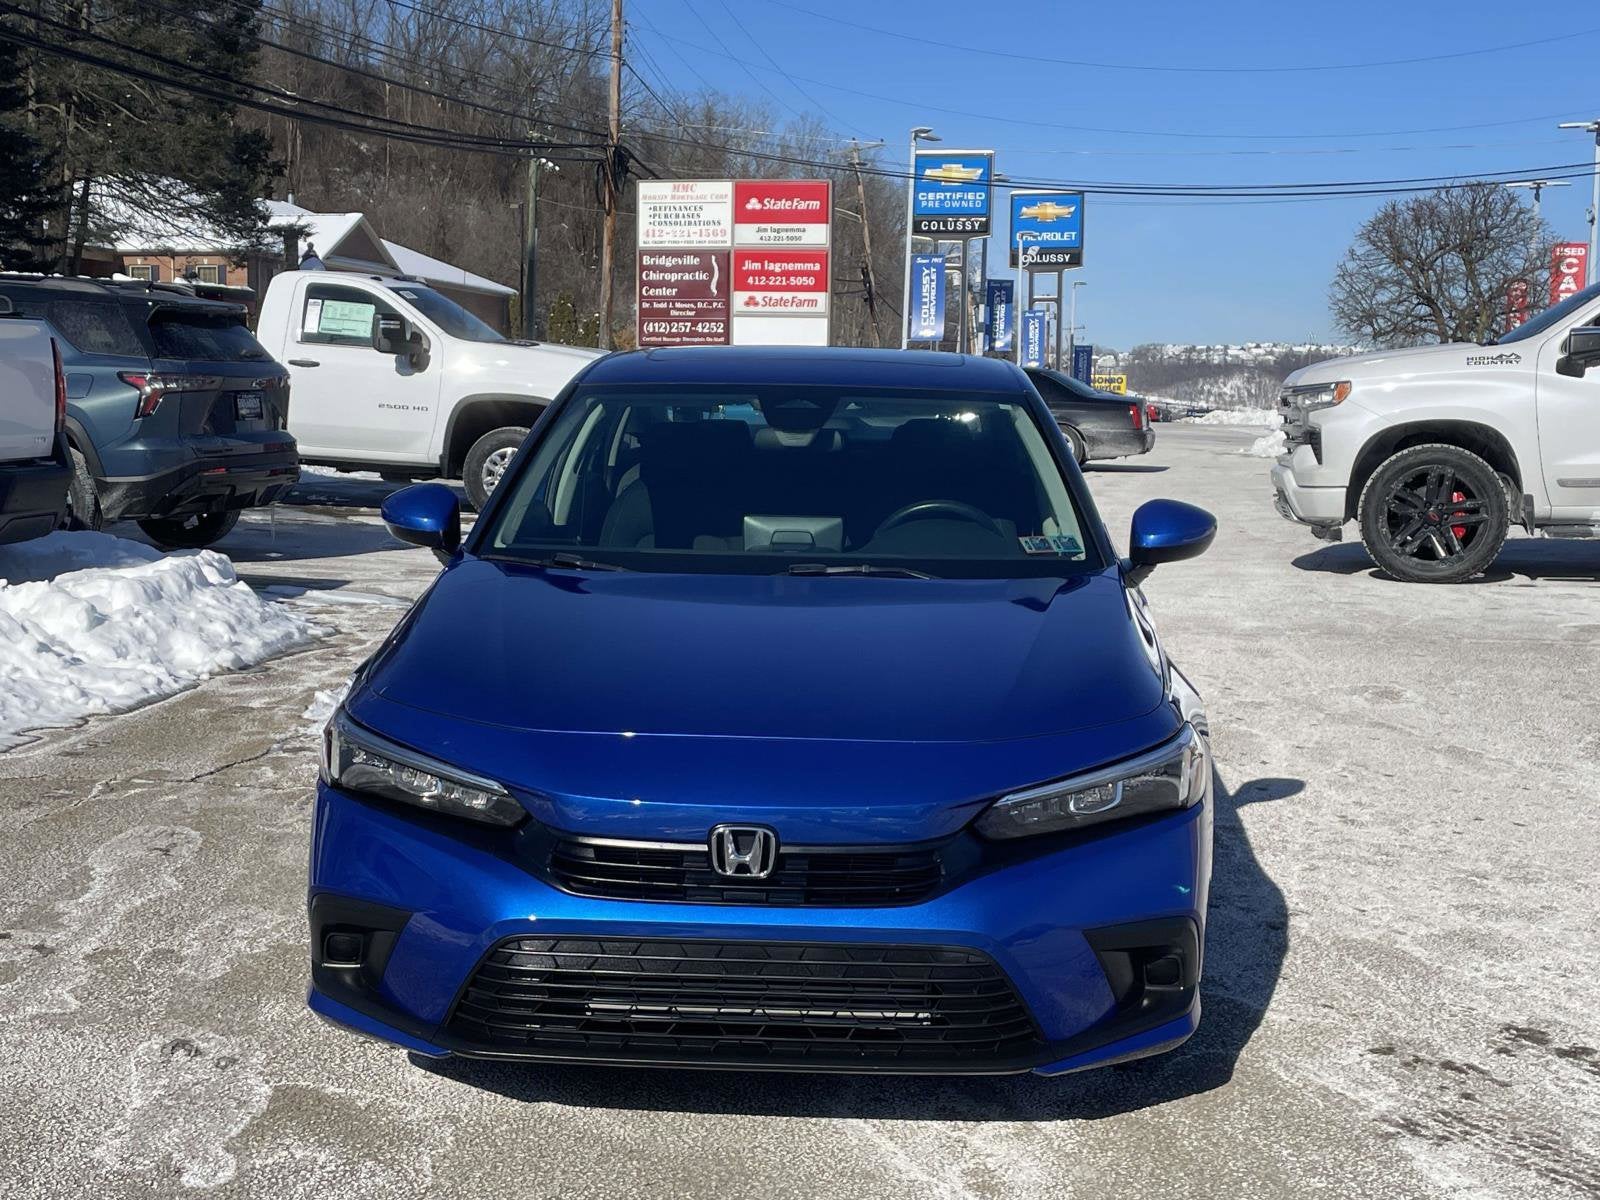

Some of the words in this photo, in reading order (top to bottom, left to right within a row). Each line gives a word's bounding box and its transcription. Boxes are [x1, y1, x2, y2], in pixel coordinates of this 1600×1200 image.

[918, 192, 986, 200] CERTIFIED
[755, 226, 768, 234] Jim
[921, 220, 981, 231] COLUSSY
[642, 255, 700, 267] Bridgeville
[742, 260, 761, 271] Jim
[642, 270, 710, 282] Chiropractic
[747, 276, 815, 286] 412-221-5050
[642, 285, 678, 296] Center
[921, 266, 931, 326] COLUSSY
[929, 266, 938, 326] CHEVROLET
[670, 309, 696, 317] Director
[643, 321, 671, 334] (412)
[670, 321, 724, 333] 257-4252
